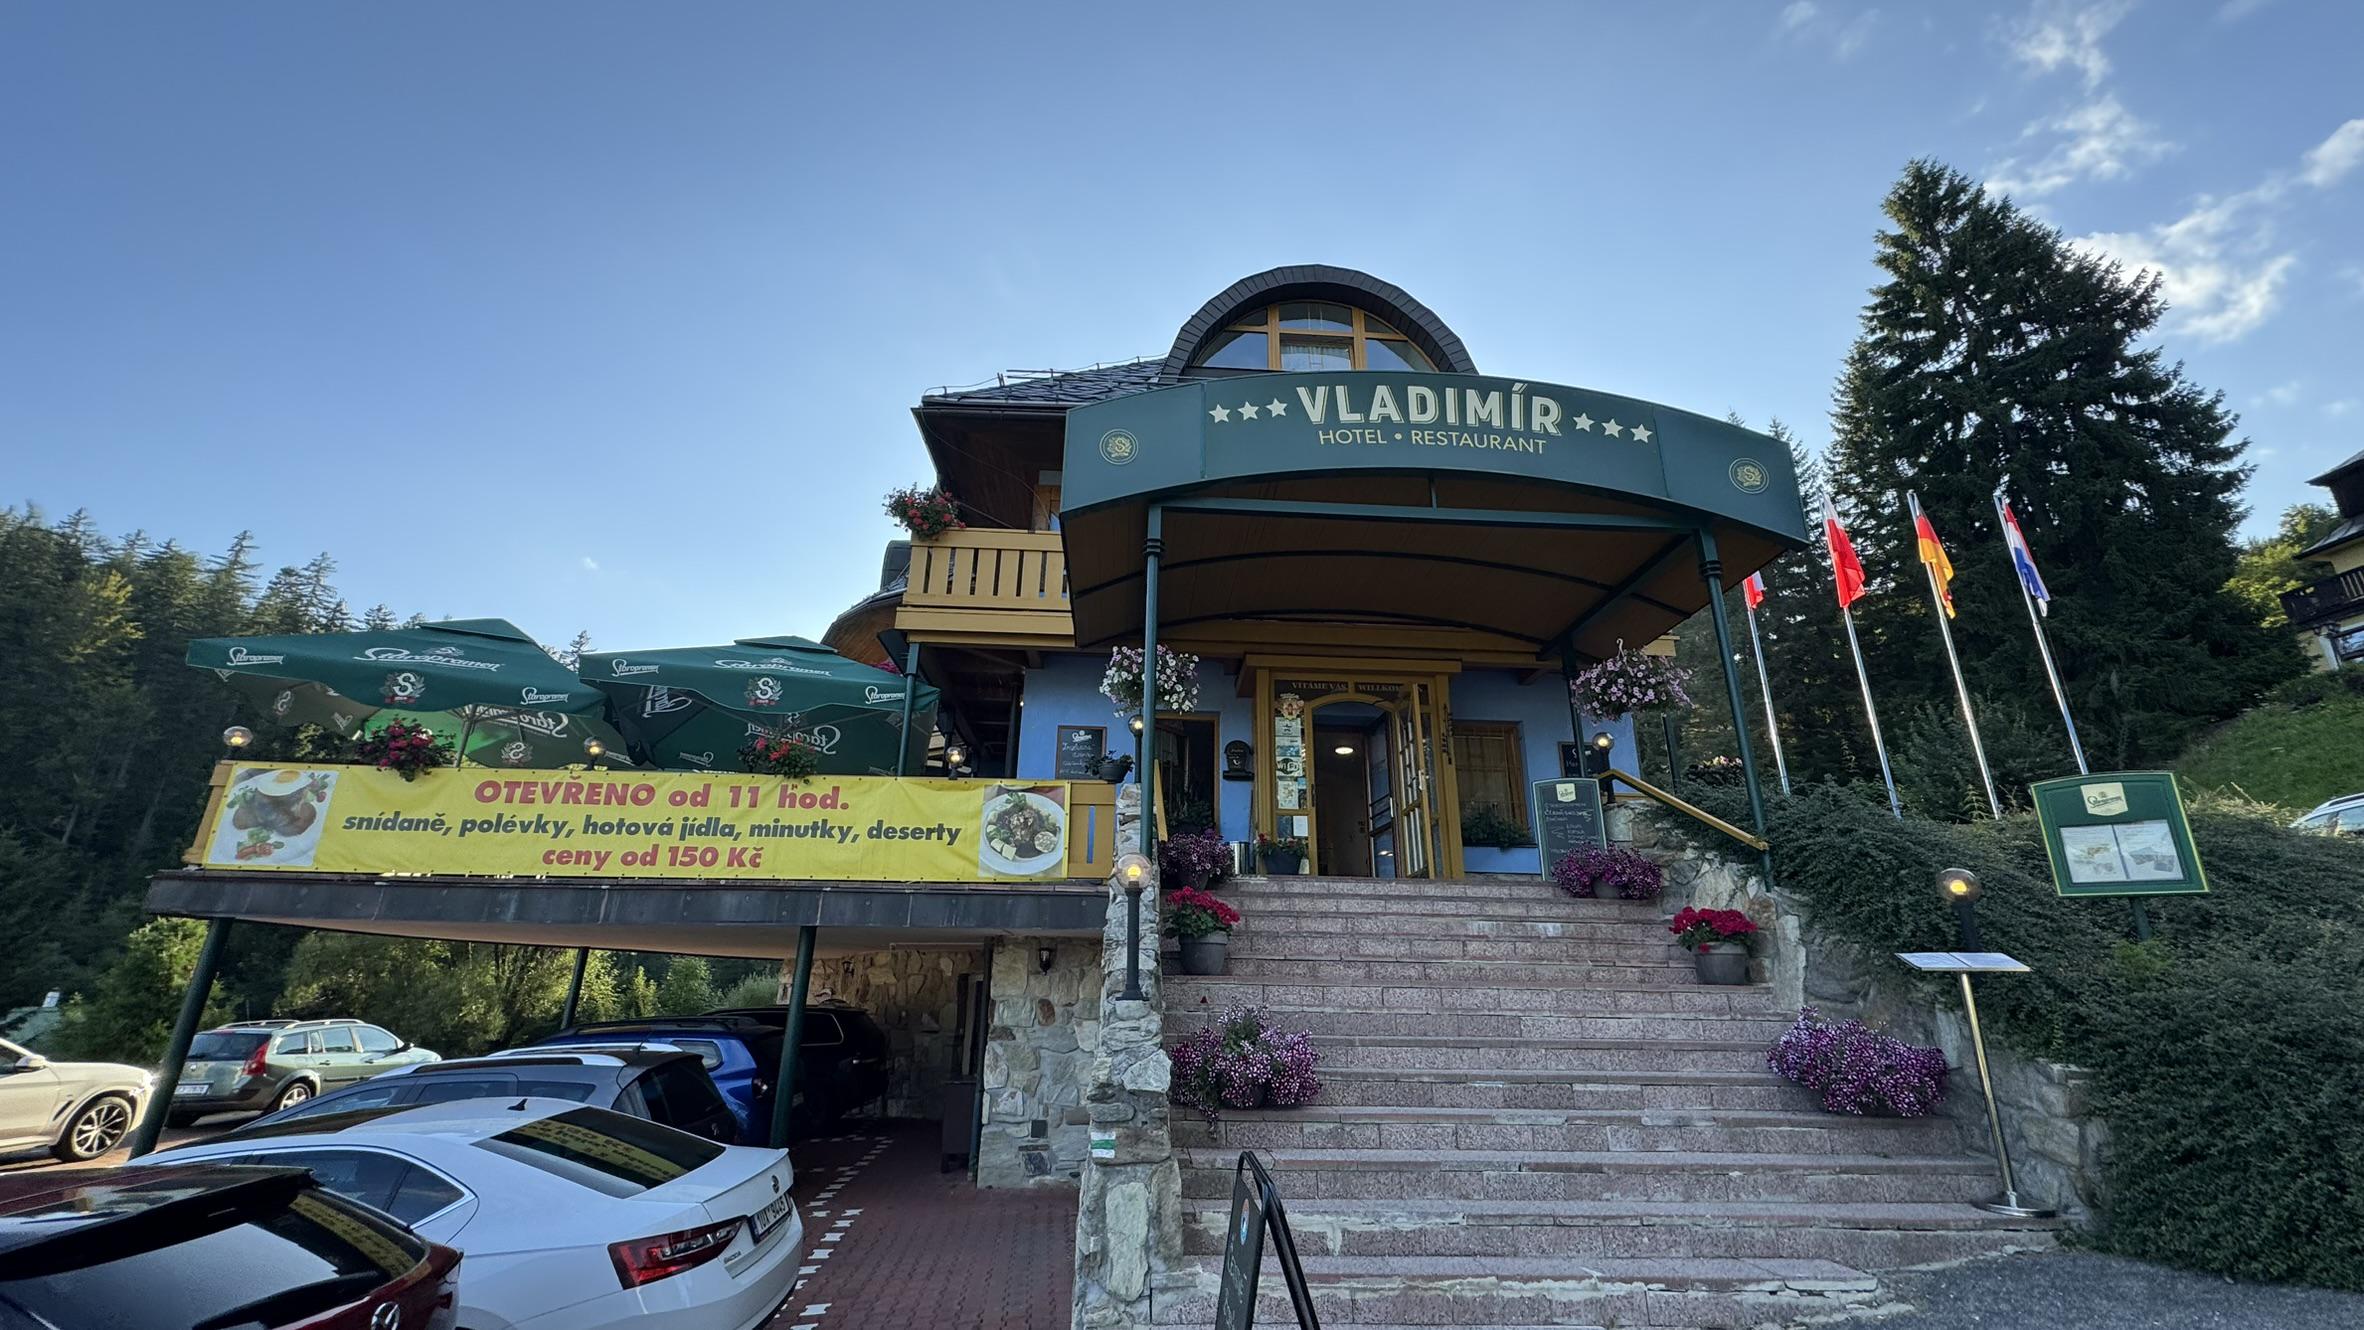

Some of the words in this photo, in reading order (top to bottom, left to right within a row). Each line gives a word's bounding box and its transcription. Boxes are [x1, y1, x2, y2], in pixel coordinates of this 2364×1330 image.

[1296, 383, 1562, 437] VLADIMÍR
[1319, 429, 1387, 445] HOTEL
[1412, 431, 1547, 454] RESTAURANT
[353, 647, 500, 672] Staropramen
[393, 672, 416, 696] S
[755, 677, 774, 700] S
[474, 776, 656, 807] OTEVŘENO
[668, 784, 711, 807] od
[729, 786, 758, 809] 11
[779, 784, 849, 810] hod.
[342, 811, 451, 836] snídaně,
[458, 813, 574, 839] polévky,
[582, 815, 673, 836] hotová
[680, 817, 741, 841] jídla,
[749, 818, 860, 844] minutky,
[867, 820, 961, 845] deserty
[542, 849, 612, 871] ceny
[620, 845, 658, 866] od
[668, 846, 719, 868] 150
[727, 846, 763, 868] Kč
